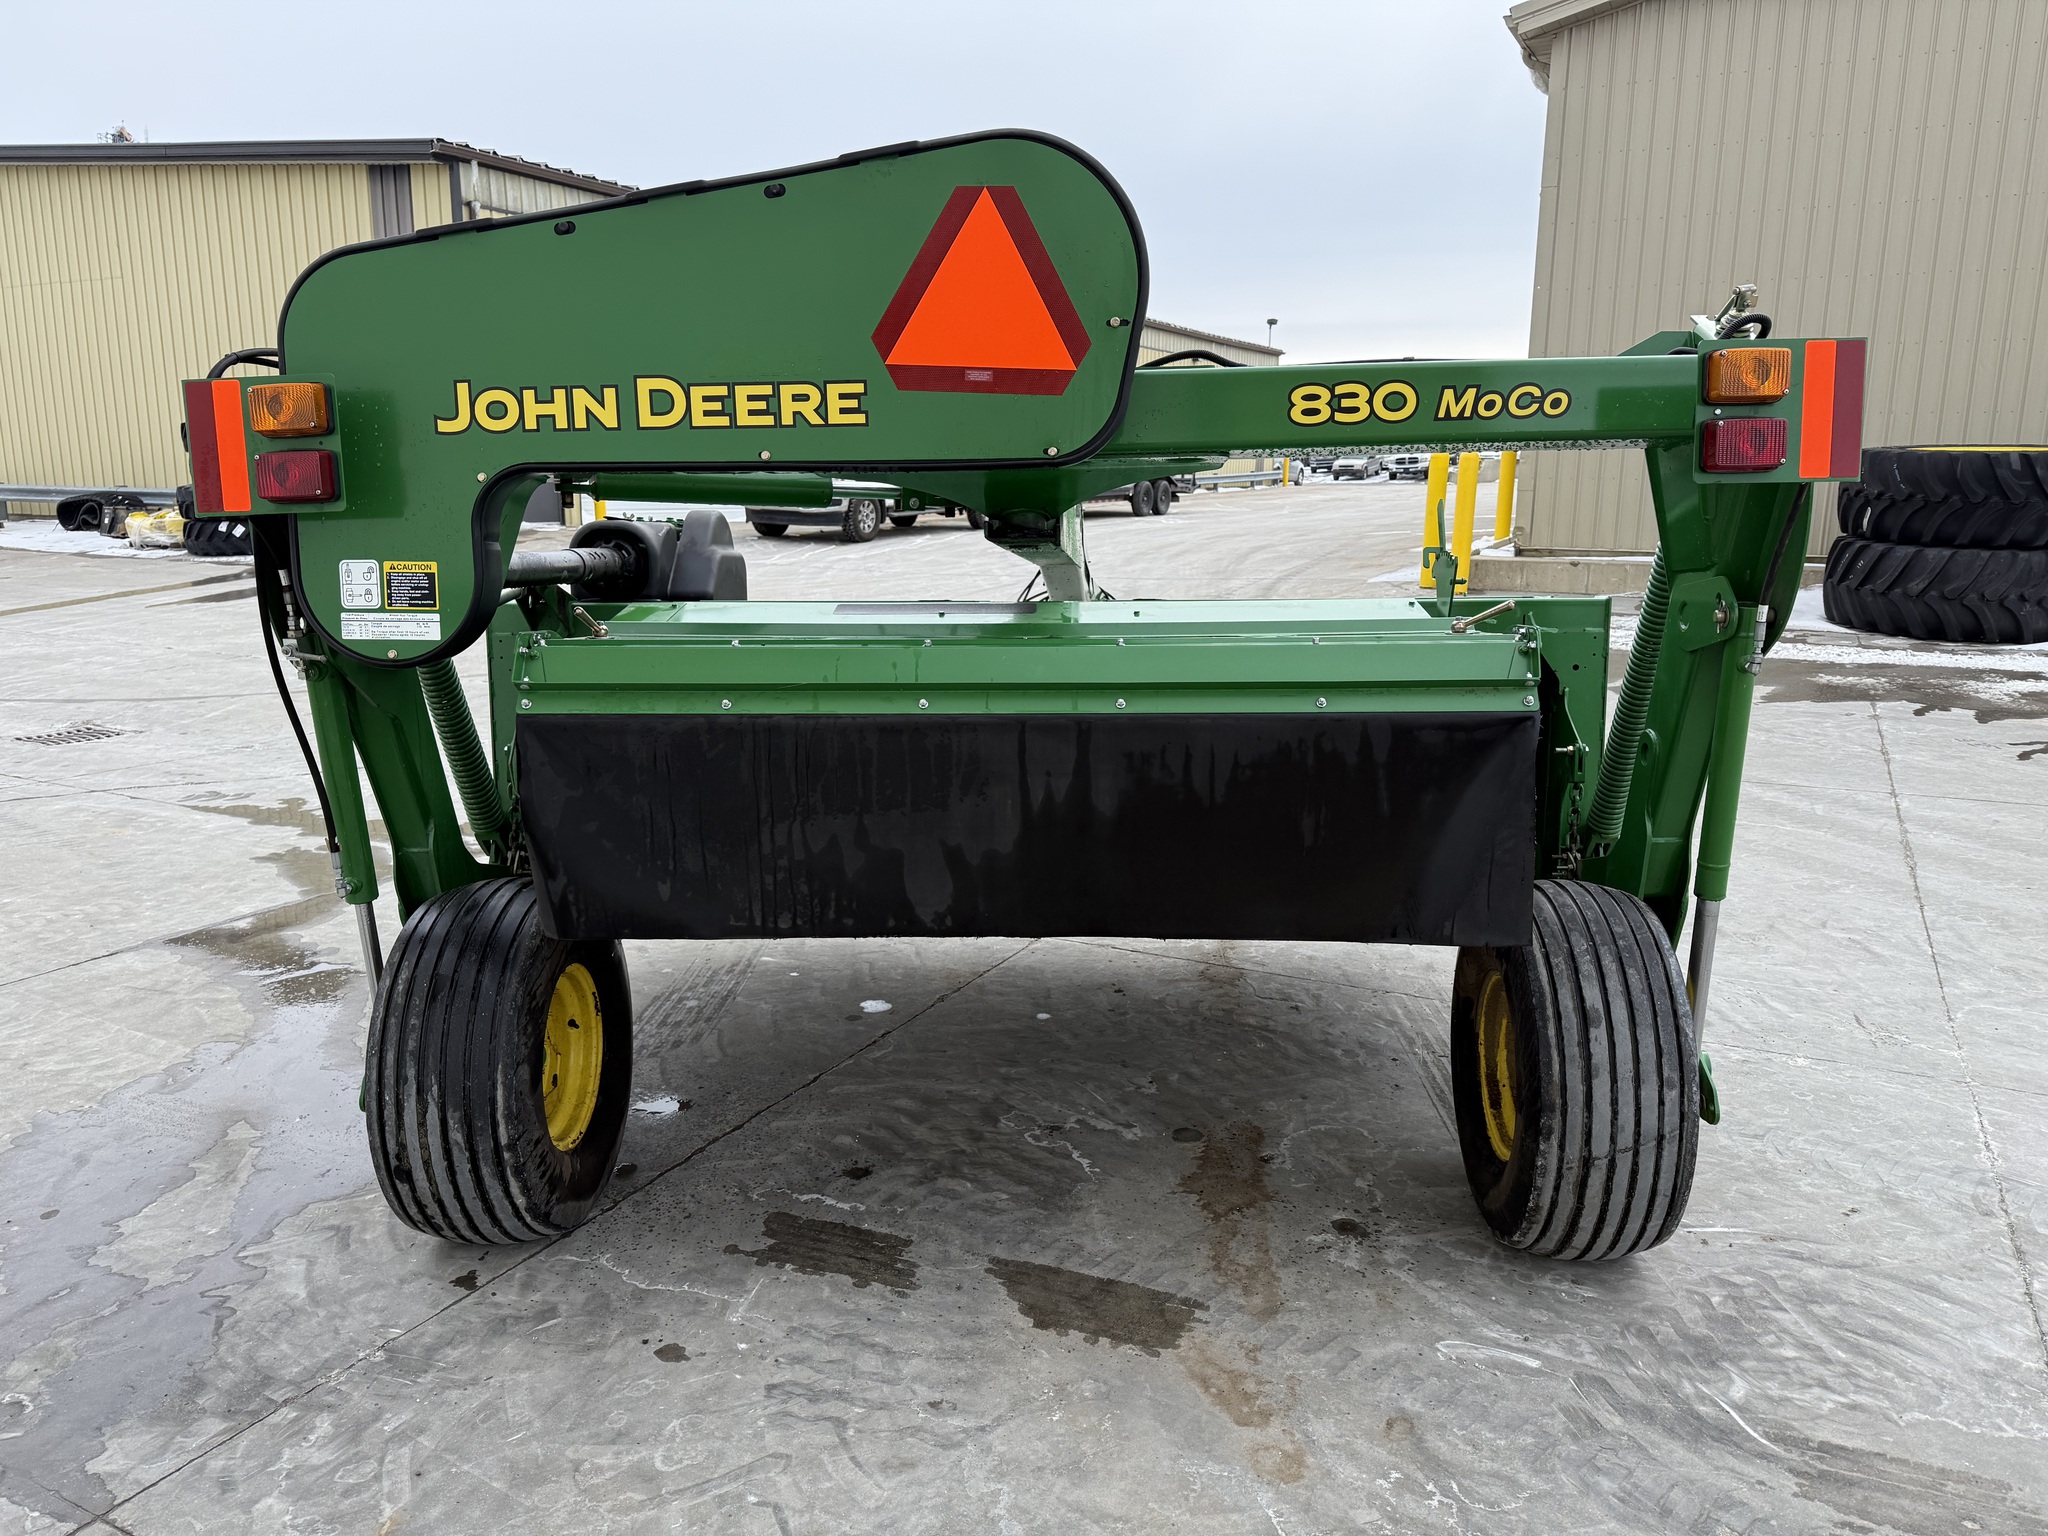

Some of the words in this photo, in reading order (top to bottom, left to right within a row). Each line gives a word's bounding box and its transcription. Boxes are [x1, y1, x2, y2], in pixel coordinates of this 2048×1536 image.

[1287, 379, 1419, 427] 830
[1433, 382, 1572, 422] MoCo
[396, 563, 432, 571] CAUTION
